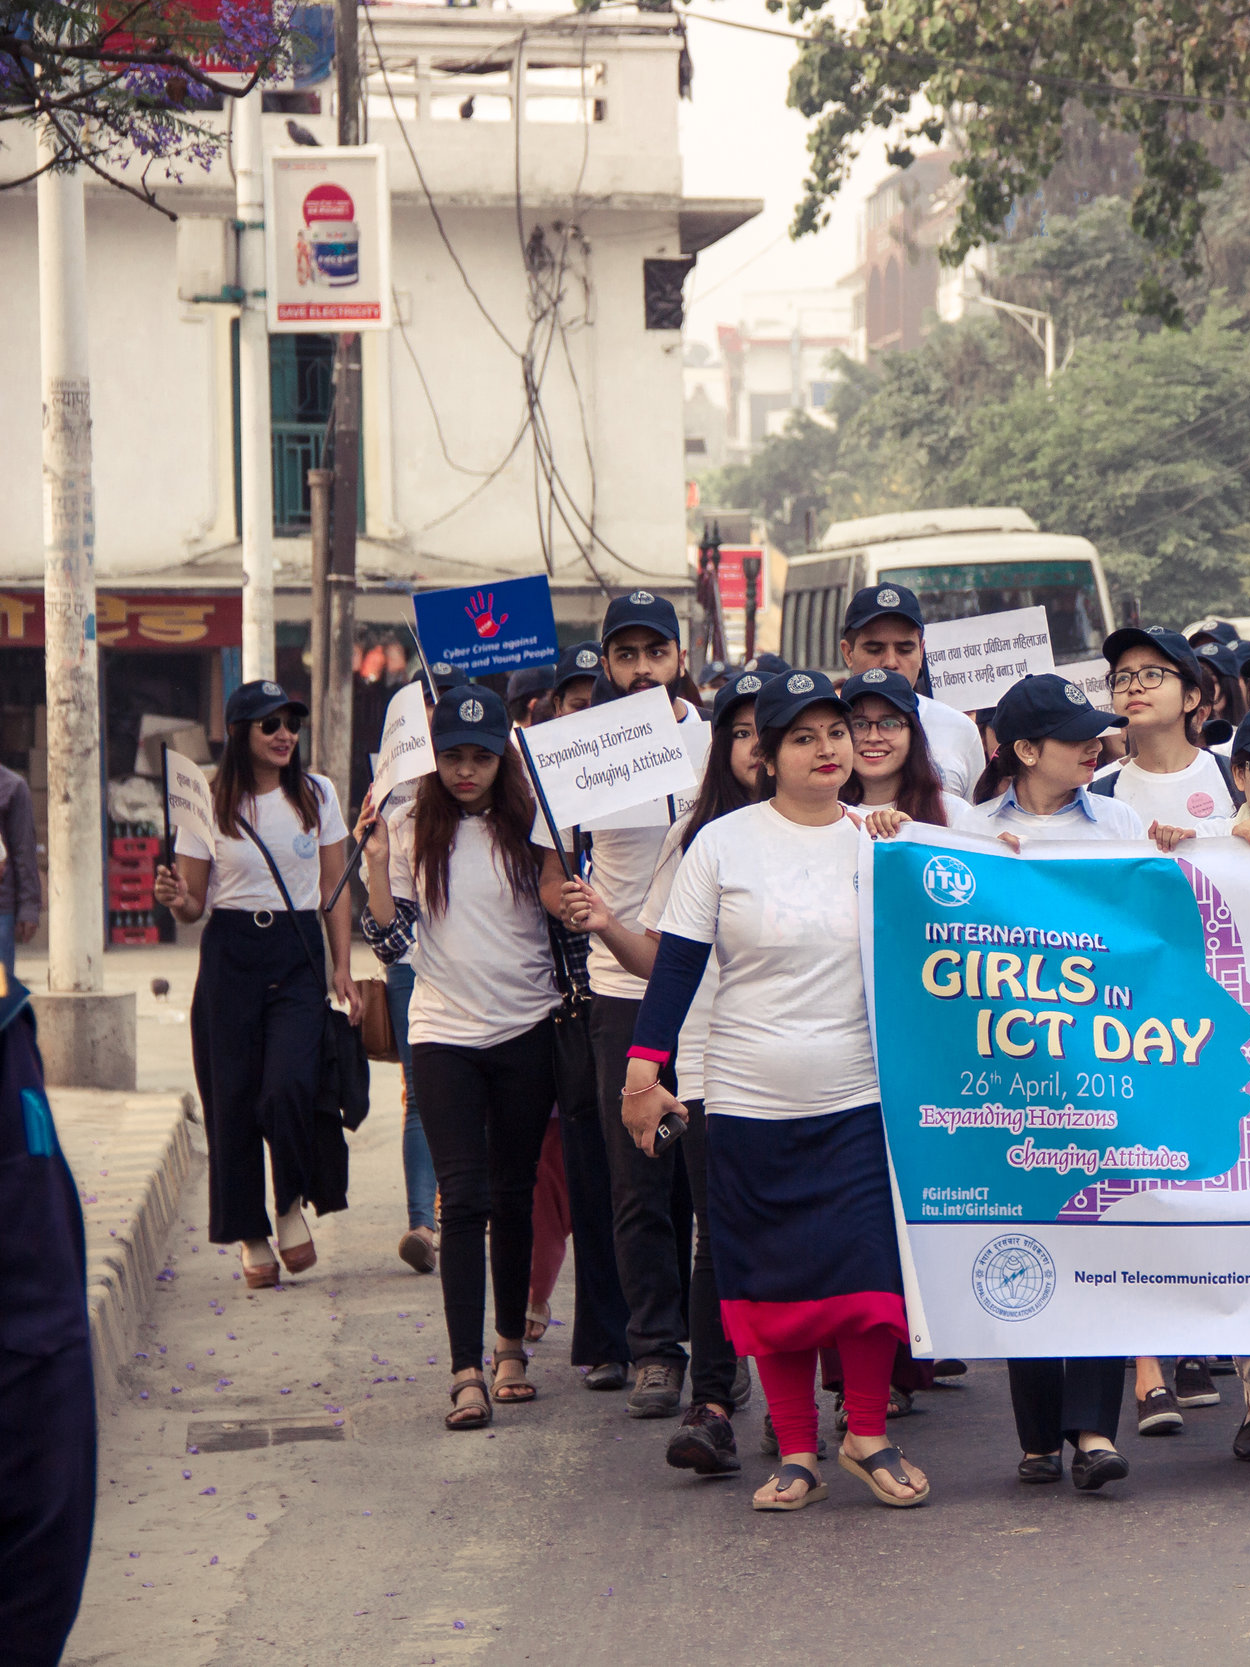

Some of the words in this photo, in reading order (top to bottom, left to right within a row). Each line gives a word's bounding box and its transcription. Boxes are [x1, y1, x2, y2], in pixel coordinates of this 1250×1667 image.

[279, 306, 306, 318] SAVE
[309, 305, 379, 317] ELECTRICITY
[443, 647, 470, 659] Cyber
[472, 642, 500, 654] Crime
[502, 636, 538, 650] against
[471, 656, 490, 669] and
[491, 652, 521, 665] Young
[523, 647, 555, 660] People
[536, 739, 600, 769] Expanding
[598, 722, 653, 749] Horizons
[575, 764, 631, 790] Changing
[631, 747, 683, 774] Attitudes
[927, 870, 972, 891] ITU
[925, 922, 1109, 953] INTERNATIONAL
[922, 950, 1097, 1004] GIRLS
[1104, 984, 1133, 1010] IN
[976, 1008, 1076, 1060] ICT
[1093, 1014, 1214, 1068] DAY
[960, 1071, 1002, 1097] 26th
[1009, 1071, 1068, 1102] April,
[1076, 1073, 1135, 1099] 2018
[920, 1103, 1025, 1134] Expanding
[1026, 1103, 1118, 1130] Horizons
[1007, 1137, 1100, 1175] Changing
[1101, 1144, 1190, 1170] Attitudes
[922, 1187, 990, 1201] #GirlsinICT
[922, 1203, 1023, 1217] itu.int/Girlsinict
[1074, 1270, 1117, 1286] Nepal
